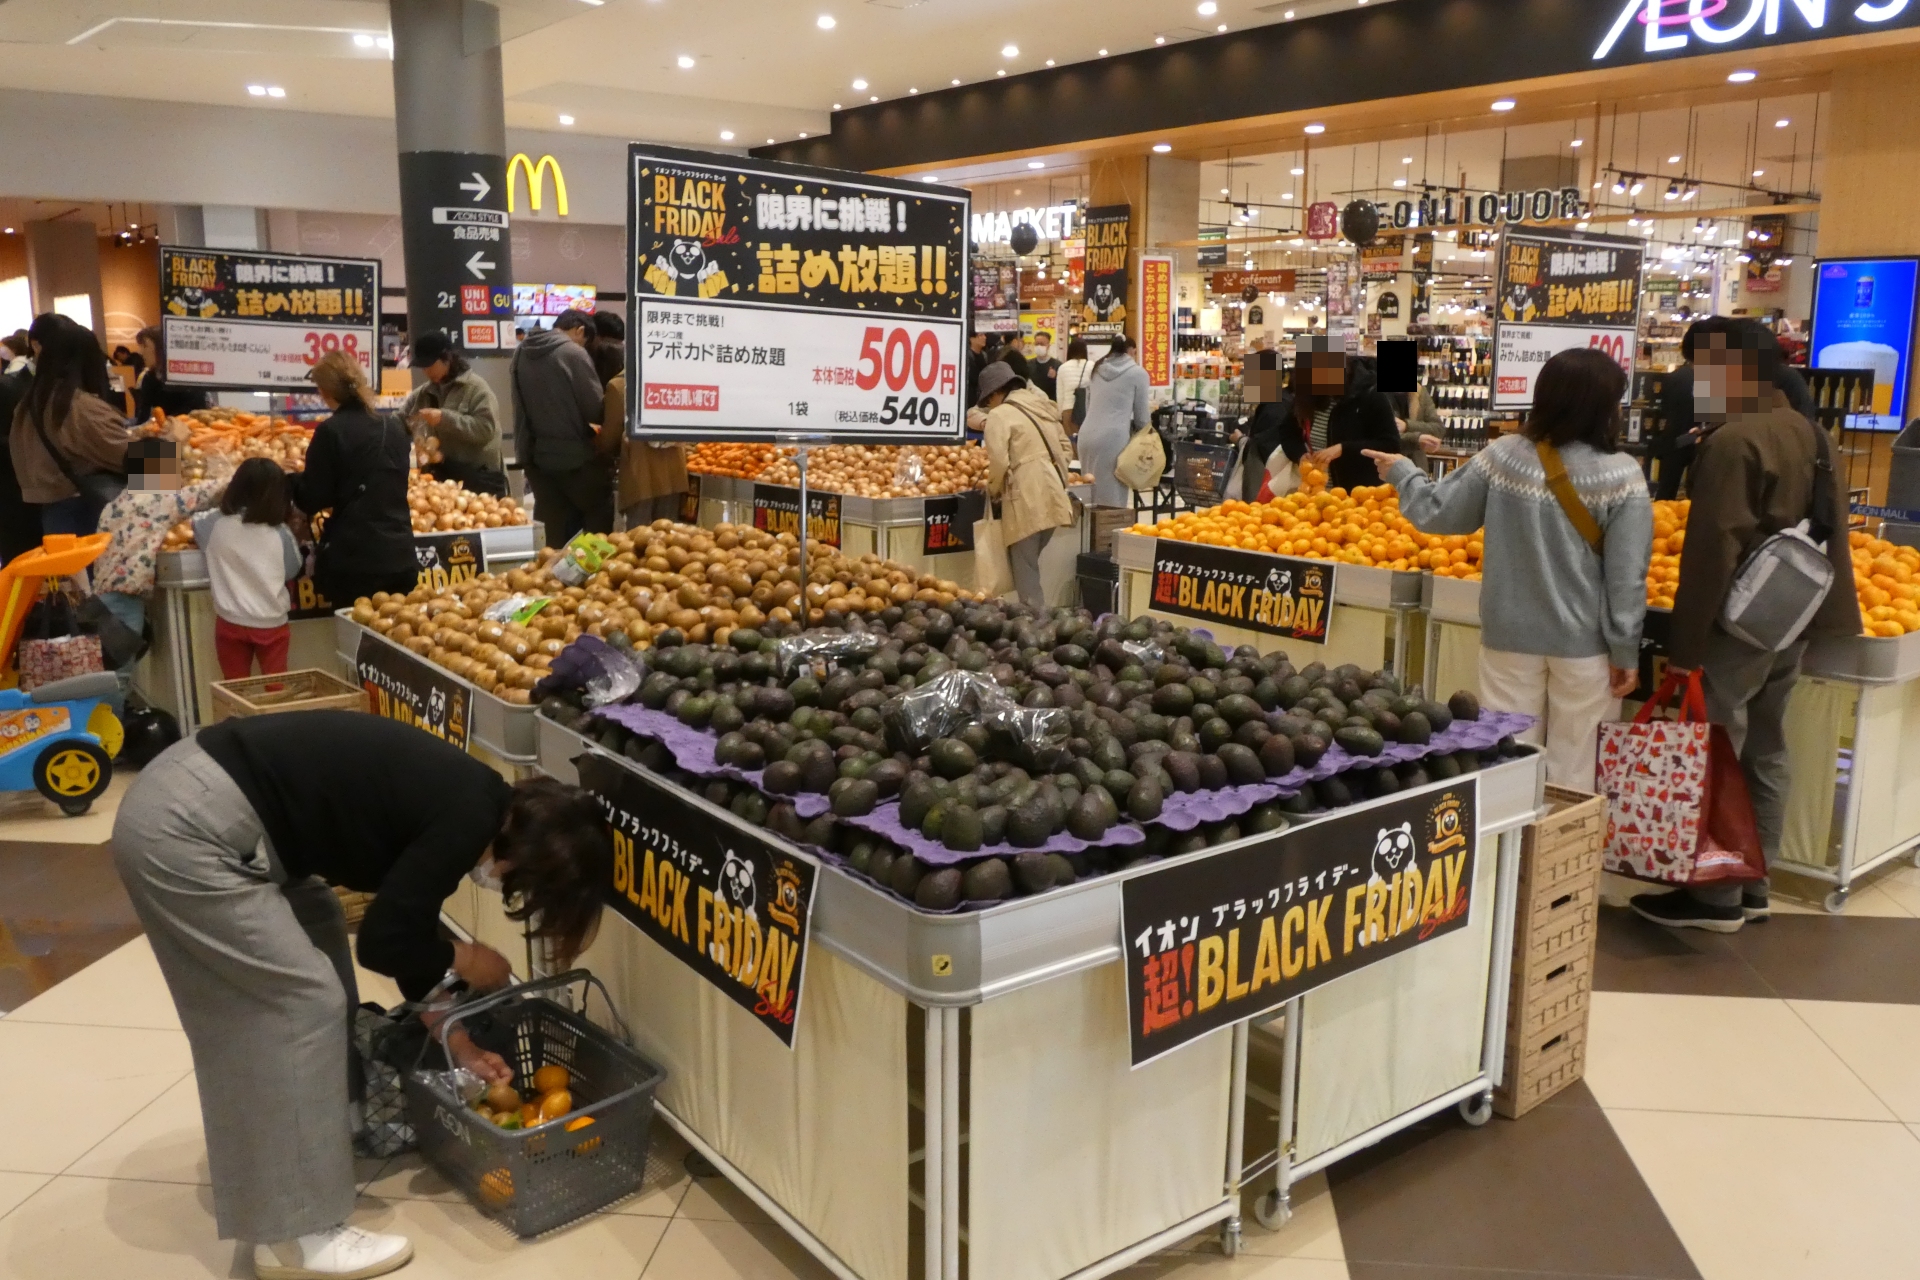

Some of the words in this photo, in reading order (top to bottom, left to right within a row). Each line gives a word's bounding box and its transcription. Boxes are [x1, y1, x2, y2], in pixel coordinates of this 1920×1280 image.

[655, 175, 726, 211] BLACK
[1444, 187, 1581, 226] LIQUOR
[478, 212, 499, 223] STYLE
[655, 205, 726, 239] FRIDAY
[453, 225, 499, 241] 食品売場
[702, 226, 740, 247] Sale
[1087, 222, 1127, 247] BLACK
[172, 256, 216, 274] BLACK
[1086, 246, 1127, 271] FRIDAY
[1510, 244, 1540, 265] BLACK
[172, 271, 216, 289] FRIDAY
[1508, 264, 1539, 284] FRIDAY
[437, 291, 456, 308] 2F
[464, 289, 485, 299] UNI
[494, 293, 510, 308] GU
[465, 300, 487, 312] QLO
[647, 330, 683, 340] メキシコ産
[647, 341, 786, 367] アボカド詰め放題
[788, 402, 808, 416] 1袋
[767, 508, 799, 534] BLACK
[927, 514, 949, 525] イオン
[1880, 508, 1909, 520] MALL
[1156, 559, 1183, 574] イオン
[1188, 565, 1261, 585] ブラックフライデー
[1249, 588, 1324, 631] FRIDAY
[1292, 620, 1325, 638] Sale
[620, 810, 710, 876] ブラックフライデー
[613, 829, 690, 944] BLACK
[698, 886, 799, 1012] FRIDAY
[1135, 916, 1199, 958] イオン
[1213, 864, 1359, 927] ブラックフライデー
[1418, 886, 1468, 940] Sale
[1197, 894, 1333, 1012] BLACK
[1343, 850, 1467, 955] FRIDAY
[754, 980, 794, 1024] Sale
